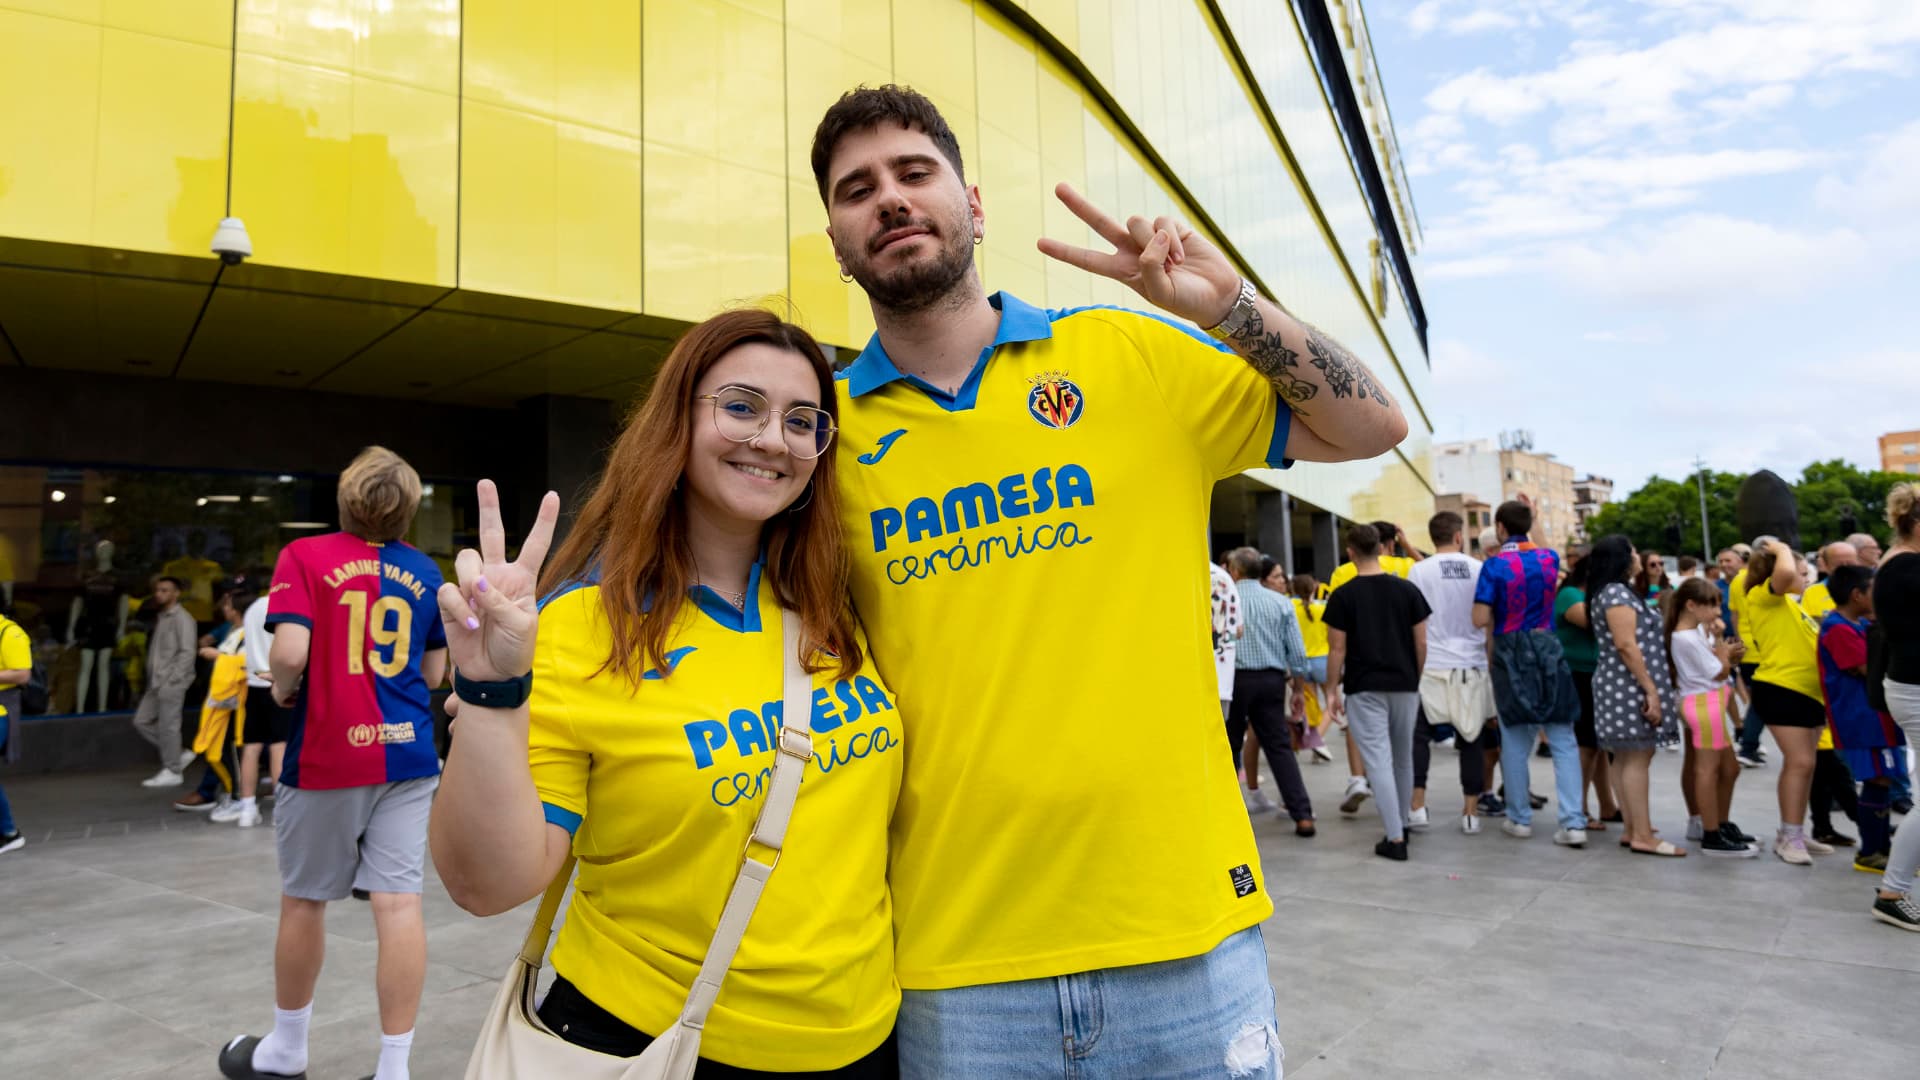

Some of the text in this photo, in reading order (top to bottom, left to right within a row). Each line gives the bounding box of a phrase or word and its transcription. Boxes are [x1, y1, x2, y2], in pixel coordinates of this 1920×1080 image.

[870, 464, 1094, 553] PAMESA
[323, 559, 426, 600] LAMINE YAMAL
[887, 522, 1093, 585] cerámica
[338, 590, 412, 678] 19
[711, 726, 898, 806] cerica
